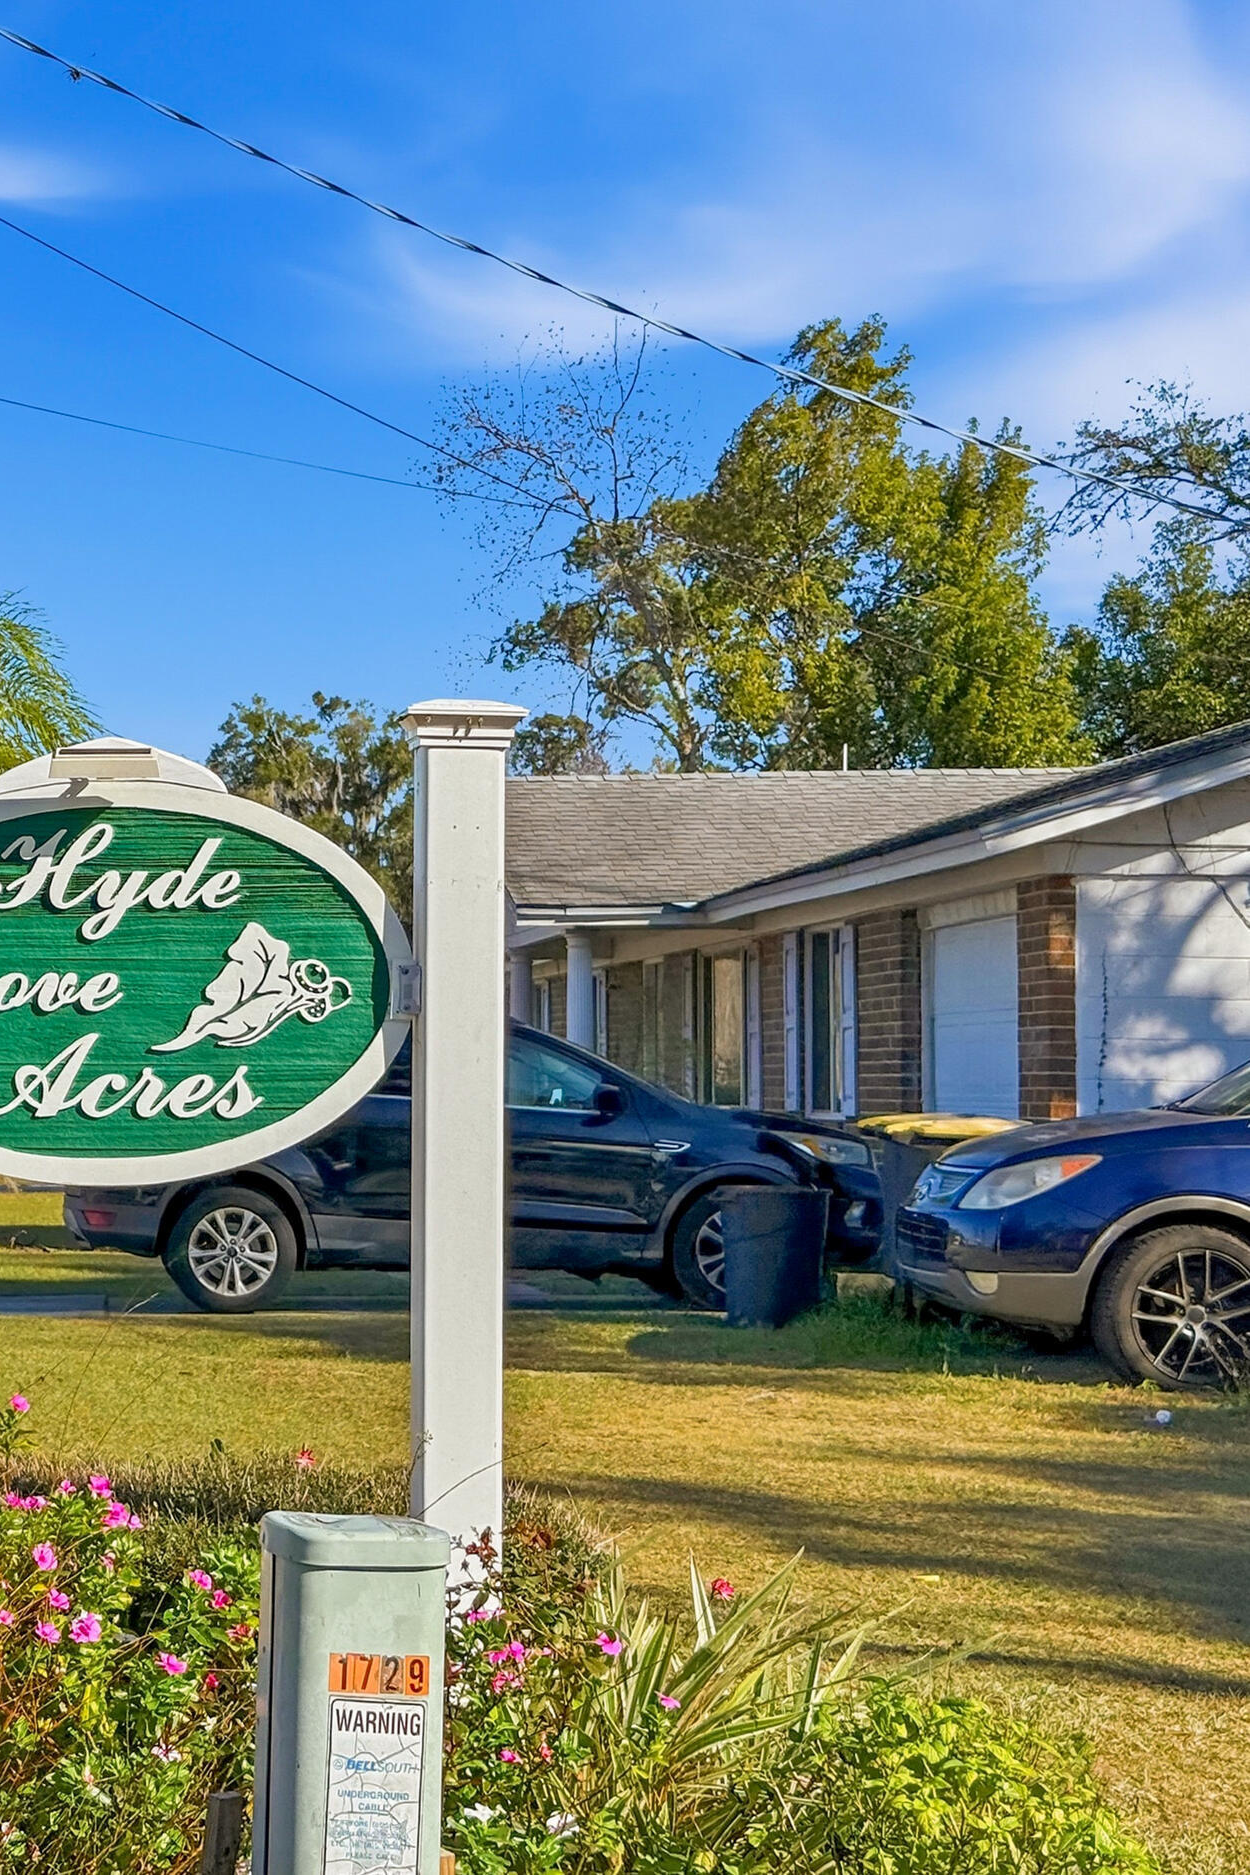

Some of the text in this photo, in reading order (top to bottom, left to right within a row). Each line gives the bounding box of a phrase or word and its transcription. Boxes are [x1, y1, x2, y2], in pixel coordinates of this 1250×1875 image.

[338, 1655, 424, 1693] 1729
[335, 1708, 421, 1736] WARNING
[337, 1789, 410, 1802] UNDERGROUND
